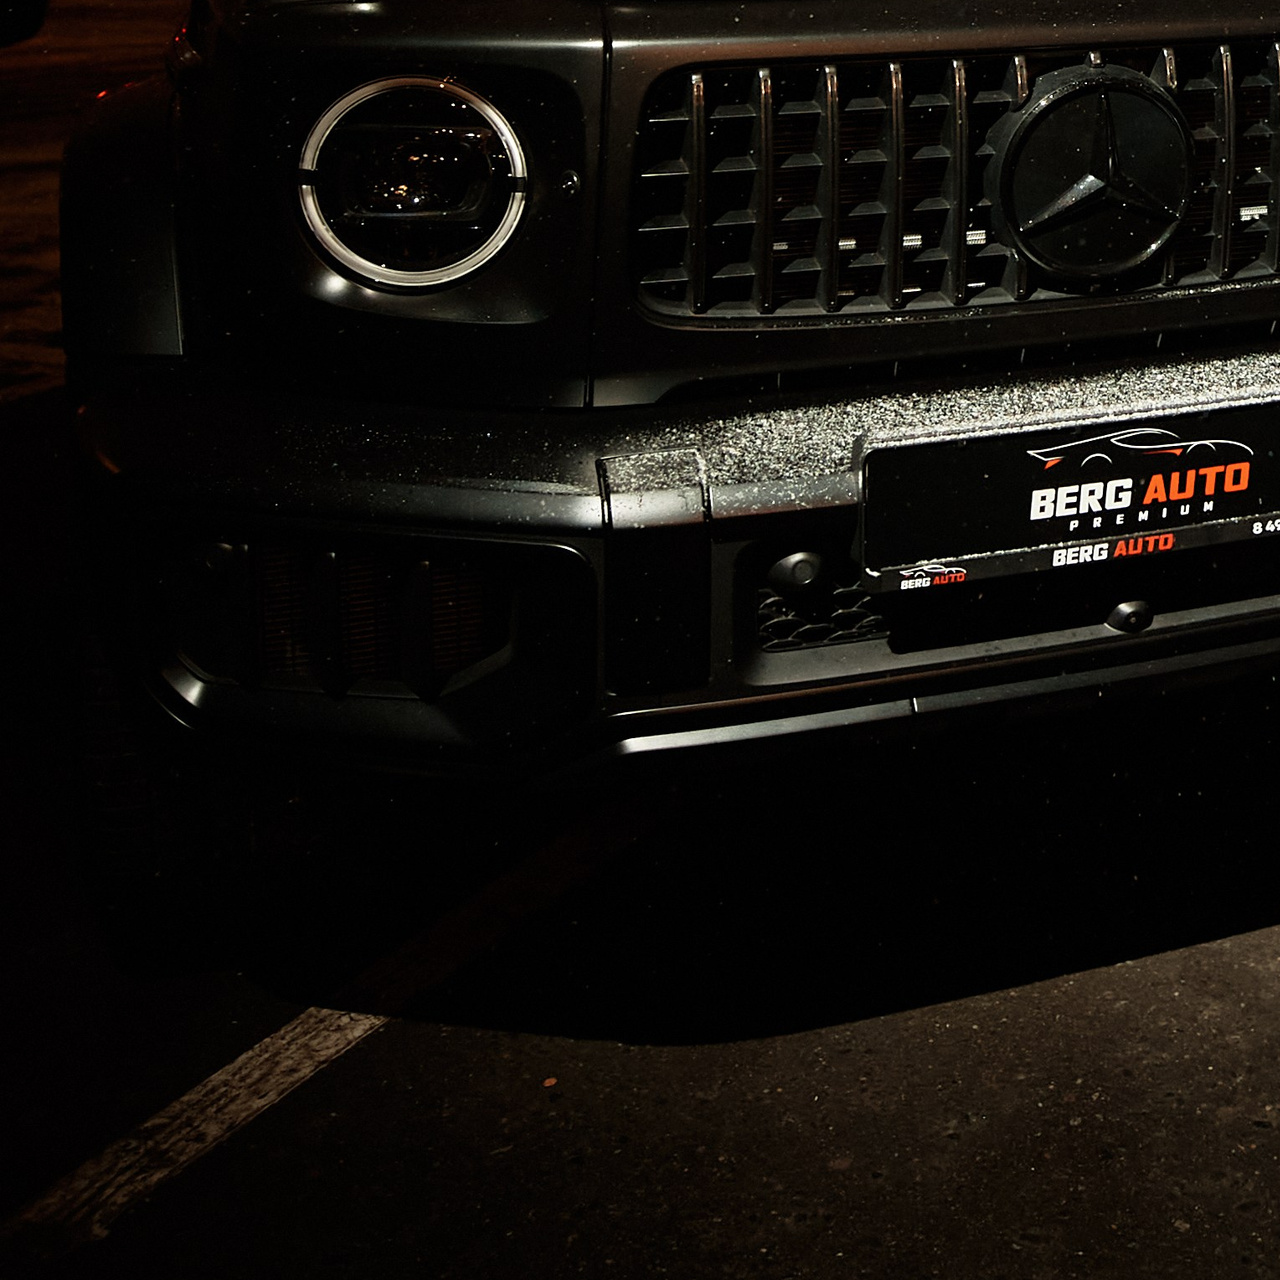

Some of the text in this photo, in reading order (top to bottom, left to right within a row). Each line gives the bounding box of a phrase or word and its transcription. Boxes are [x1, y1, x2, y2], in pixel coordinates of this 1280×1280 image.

[1030, 462, 1250, 521] BERG AUTO
[1069, 501, 1214, 532] PREMIUM
[1252, 522, 1263, 535] 8
[1052, 533, 1174, 567] BERG AUTO
[900, 572, 966, 590] BERG AUTO
